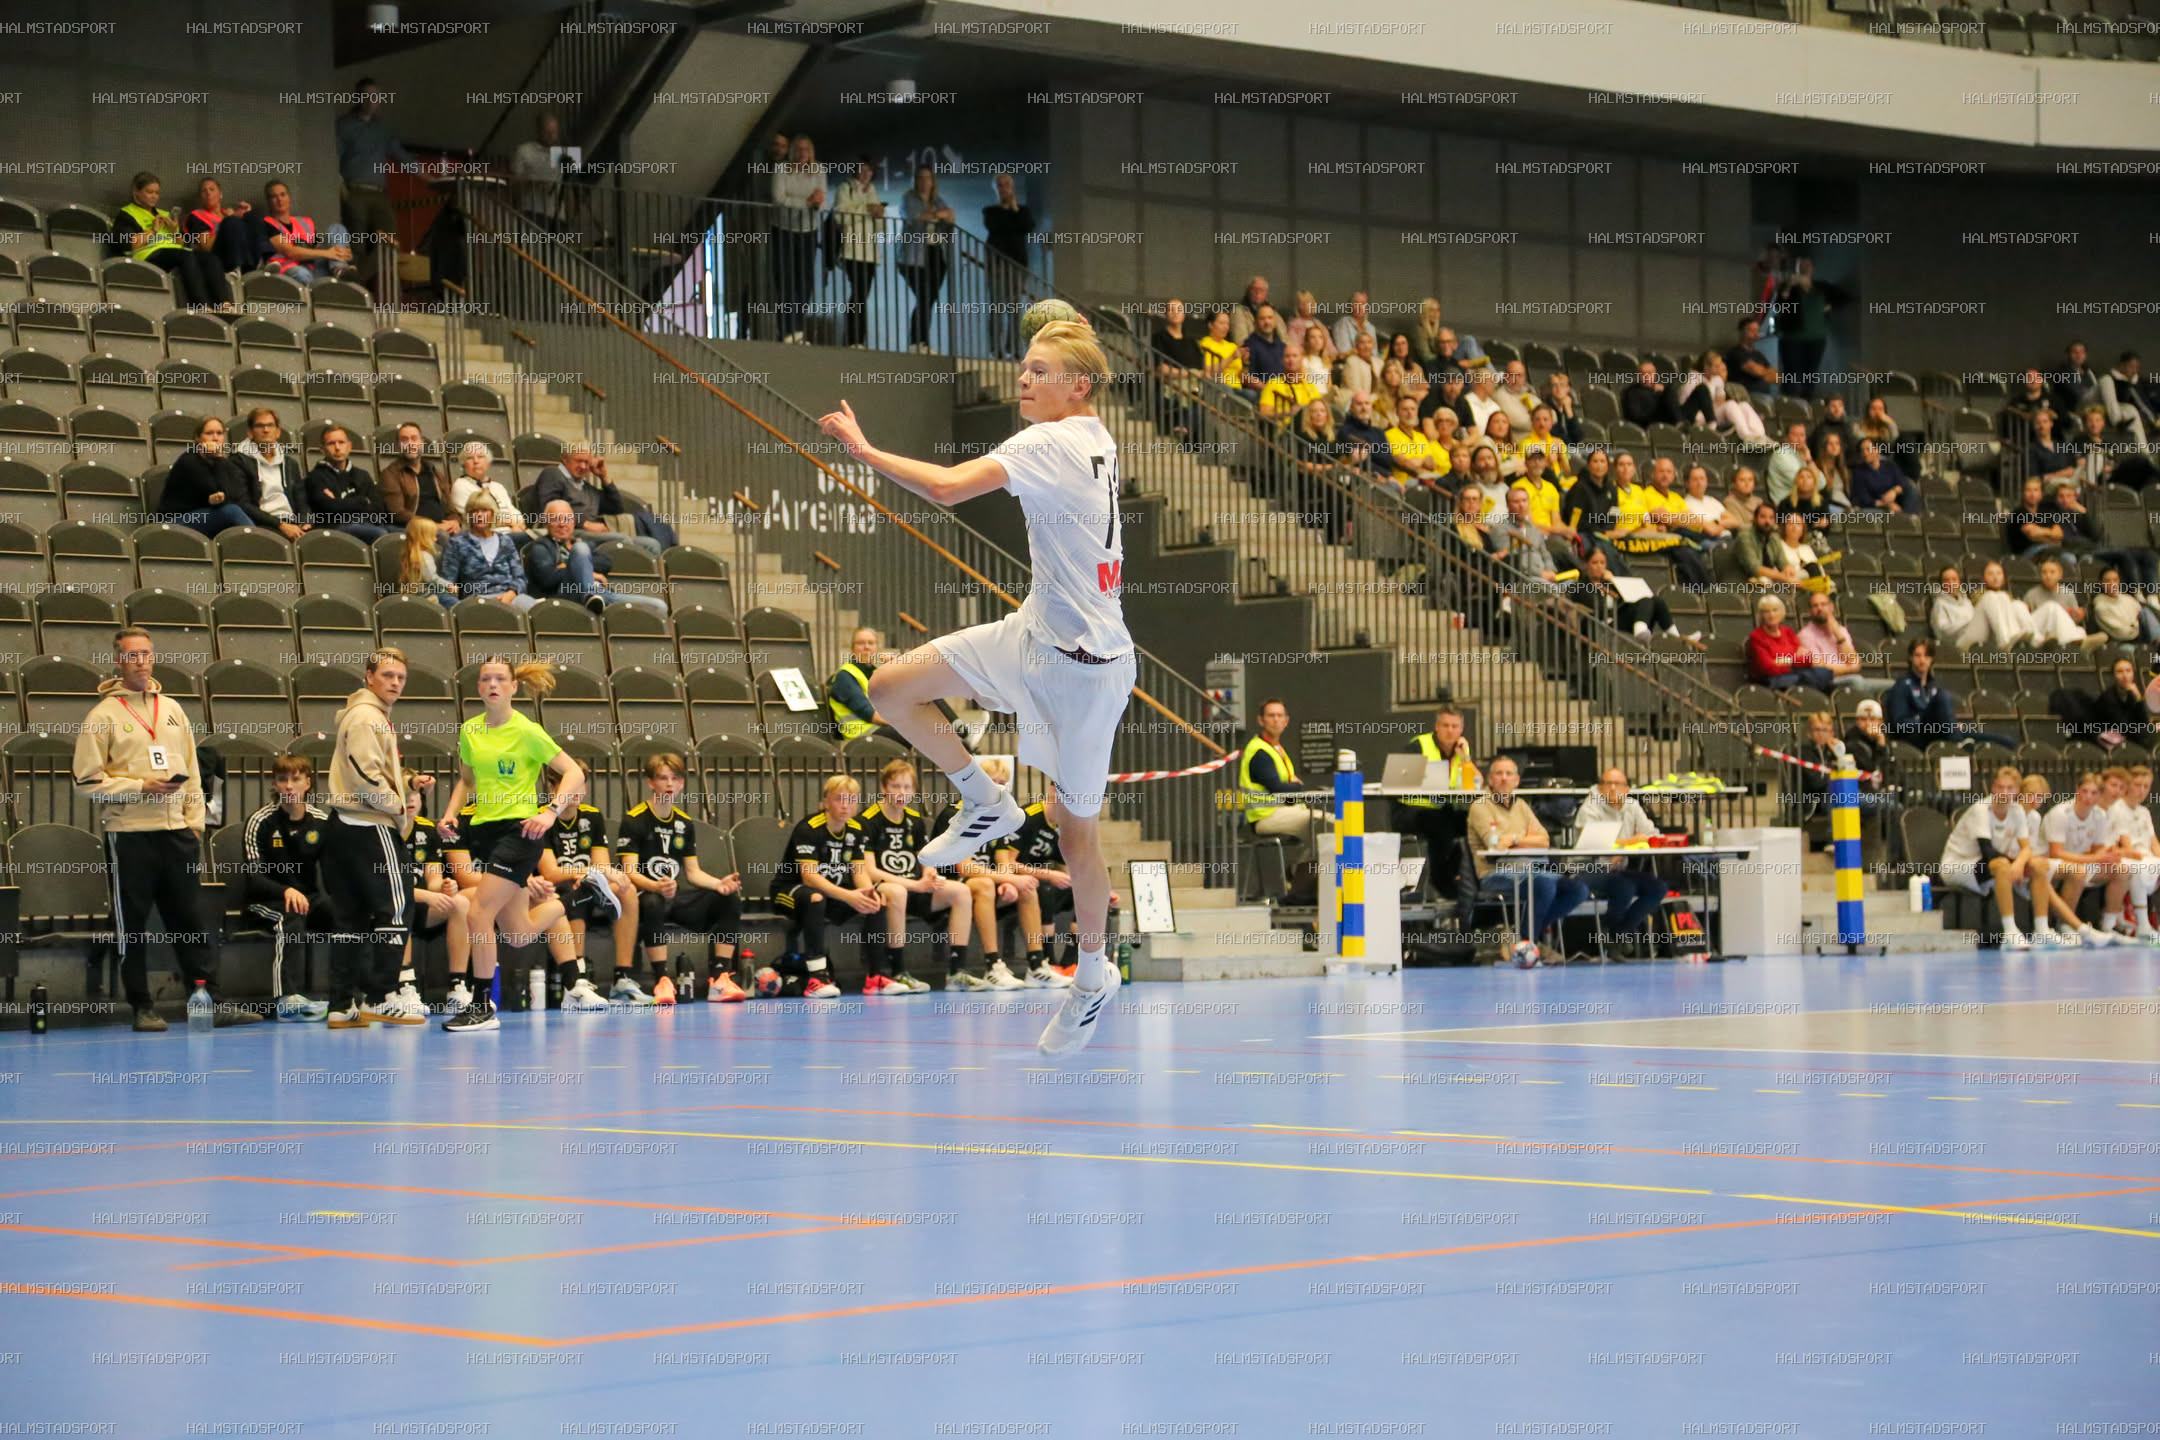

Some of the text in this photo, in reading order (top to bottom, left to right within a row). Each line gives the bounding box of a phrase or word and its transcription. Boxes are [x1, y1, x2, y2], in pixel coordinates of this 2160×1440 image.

[153, 752, 165, 765] B
[562, 838, 577, 856] 35
[889, 834, 903, 850] 25
